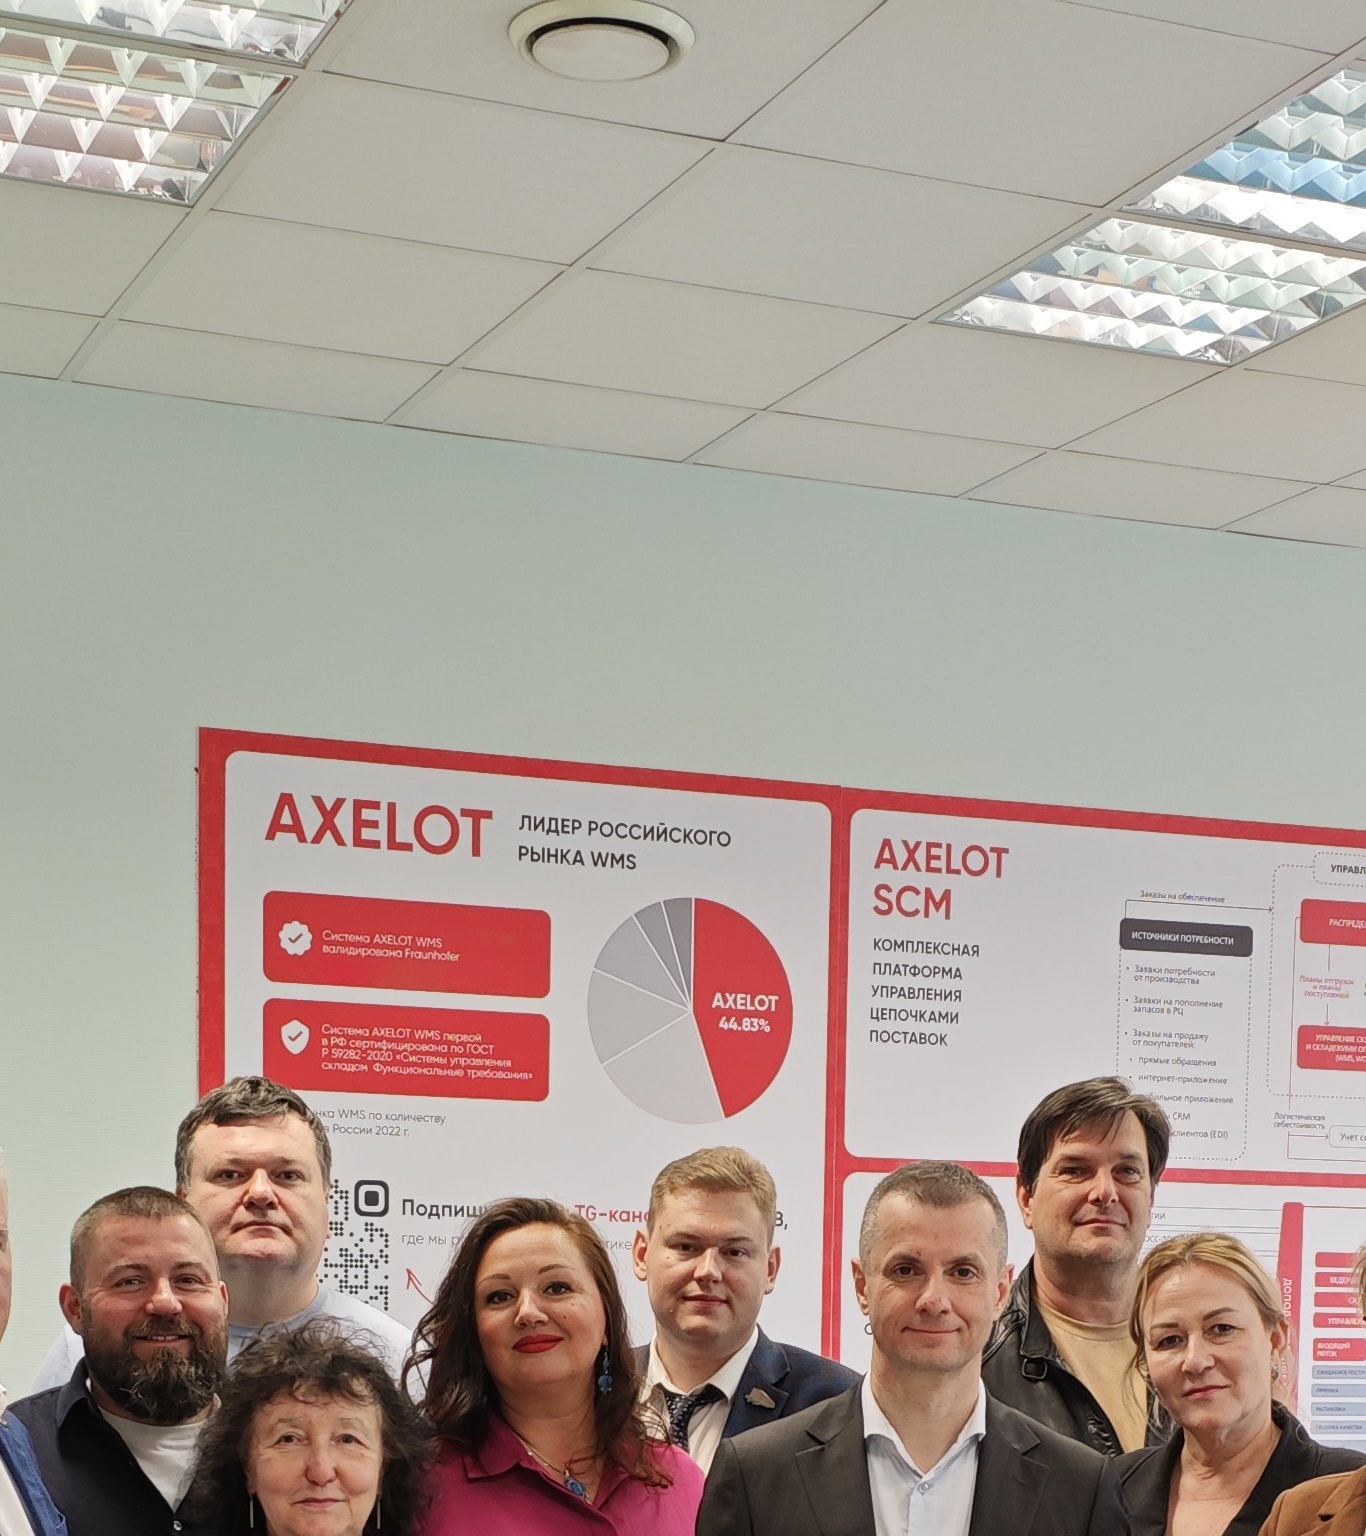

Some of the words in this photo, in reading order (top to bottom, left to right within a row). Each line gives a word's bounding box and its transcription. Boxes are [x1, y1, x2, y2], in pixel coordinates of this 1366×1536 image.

[265, 792, 493, 857] AXELOT
[519, 814, 582, 836] ЛИДЕР
[588, 820, 731, 847] РОССИЙСКОГО
[518, 846, 585, 866] РЫНКА
[591, 851, 637, 870] WMS
[874, 838, 1009, 878] AXELOT
[873, 883, 951, 920] SCM
[1140, 890, 1166, 898] Заказы
[322, 930, 370, 944] Система
[373, 933, 413, 946] AXELOT
[416, 936, 442, 948] WMS
[1132, 932, 1179, 940] ИСТОЧНИКИ
[1181, 935, 1234, 945] ПОТРЕБНОСТИ
[323, 944, 403, 958] валидирована
[405, 948, 460, 962] Fraunhofer
[873, 938, 980, 957] КОМПЛЕКСНАЯ
[873, 963, 962, 980] ПЛАТФОРМА
[1135, 965, 1162, 974] Заявки
[1164, 968, 1215, 976] потребности
[711, 992, 779, 1012] AXELOT
[871, 985, 962, 1002] УПРАВЛЕНИЯ
[719, 1016, 771, 1032] 44.83%
[870, 1007, 959, 1024] ЦЕПОЧКАМИ
[322, 1024, 369, 1037] Система
[372, 1027, 411, 1038] AXELOT
[414, 1030, 440, 1040] WMS
[443, 1032, 481, 1043] первой
[870, 1030, 948, 1046] ПОСТАВОК
[1133, 1029, 1161, 1037] Заказы
[330, 1038, 346, 1047] РФ
[349, 1040, 447, 1053] сертифицирована
[451, 1045, 464, 1053] по
[467, 1044, 494, 1055] ГОСТ
[332, 1051, 393, 1061] 59282-2020
[450, 1056, 511, 1067] управления
[322, 1062, 368, 1072] складом
[373, 1064, 464, 1077] Функциональные
[338, 1109, 365, 1120] WMS
[369, 1112, 381, 1121] по
[386, 1112, 446, 1125] количеству
[1173, 1112, 1191, 1120] CRM
[333, 1125, 373, 1136] России
[376, 1126, 400, 1136] 2022
[1210, 1130, 1228, 1139] (EDI)
[1340, 1132, 1359, 1142] Учет
[402, 1199, 487, 1219] Подпиш
[402, 1235, 424, 1245] где
[429, 1236, 446, 1244] мы
